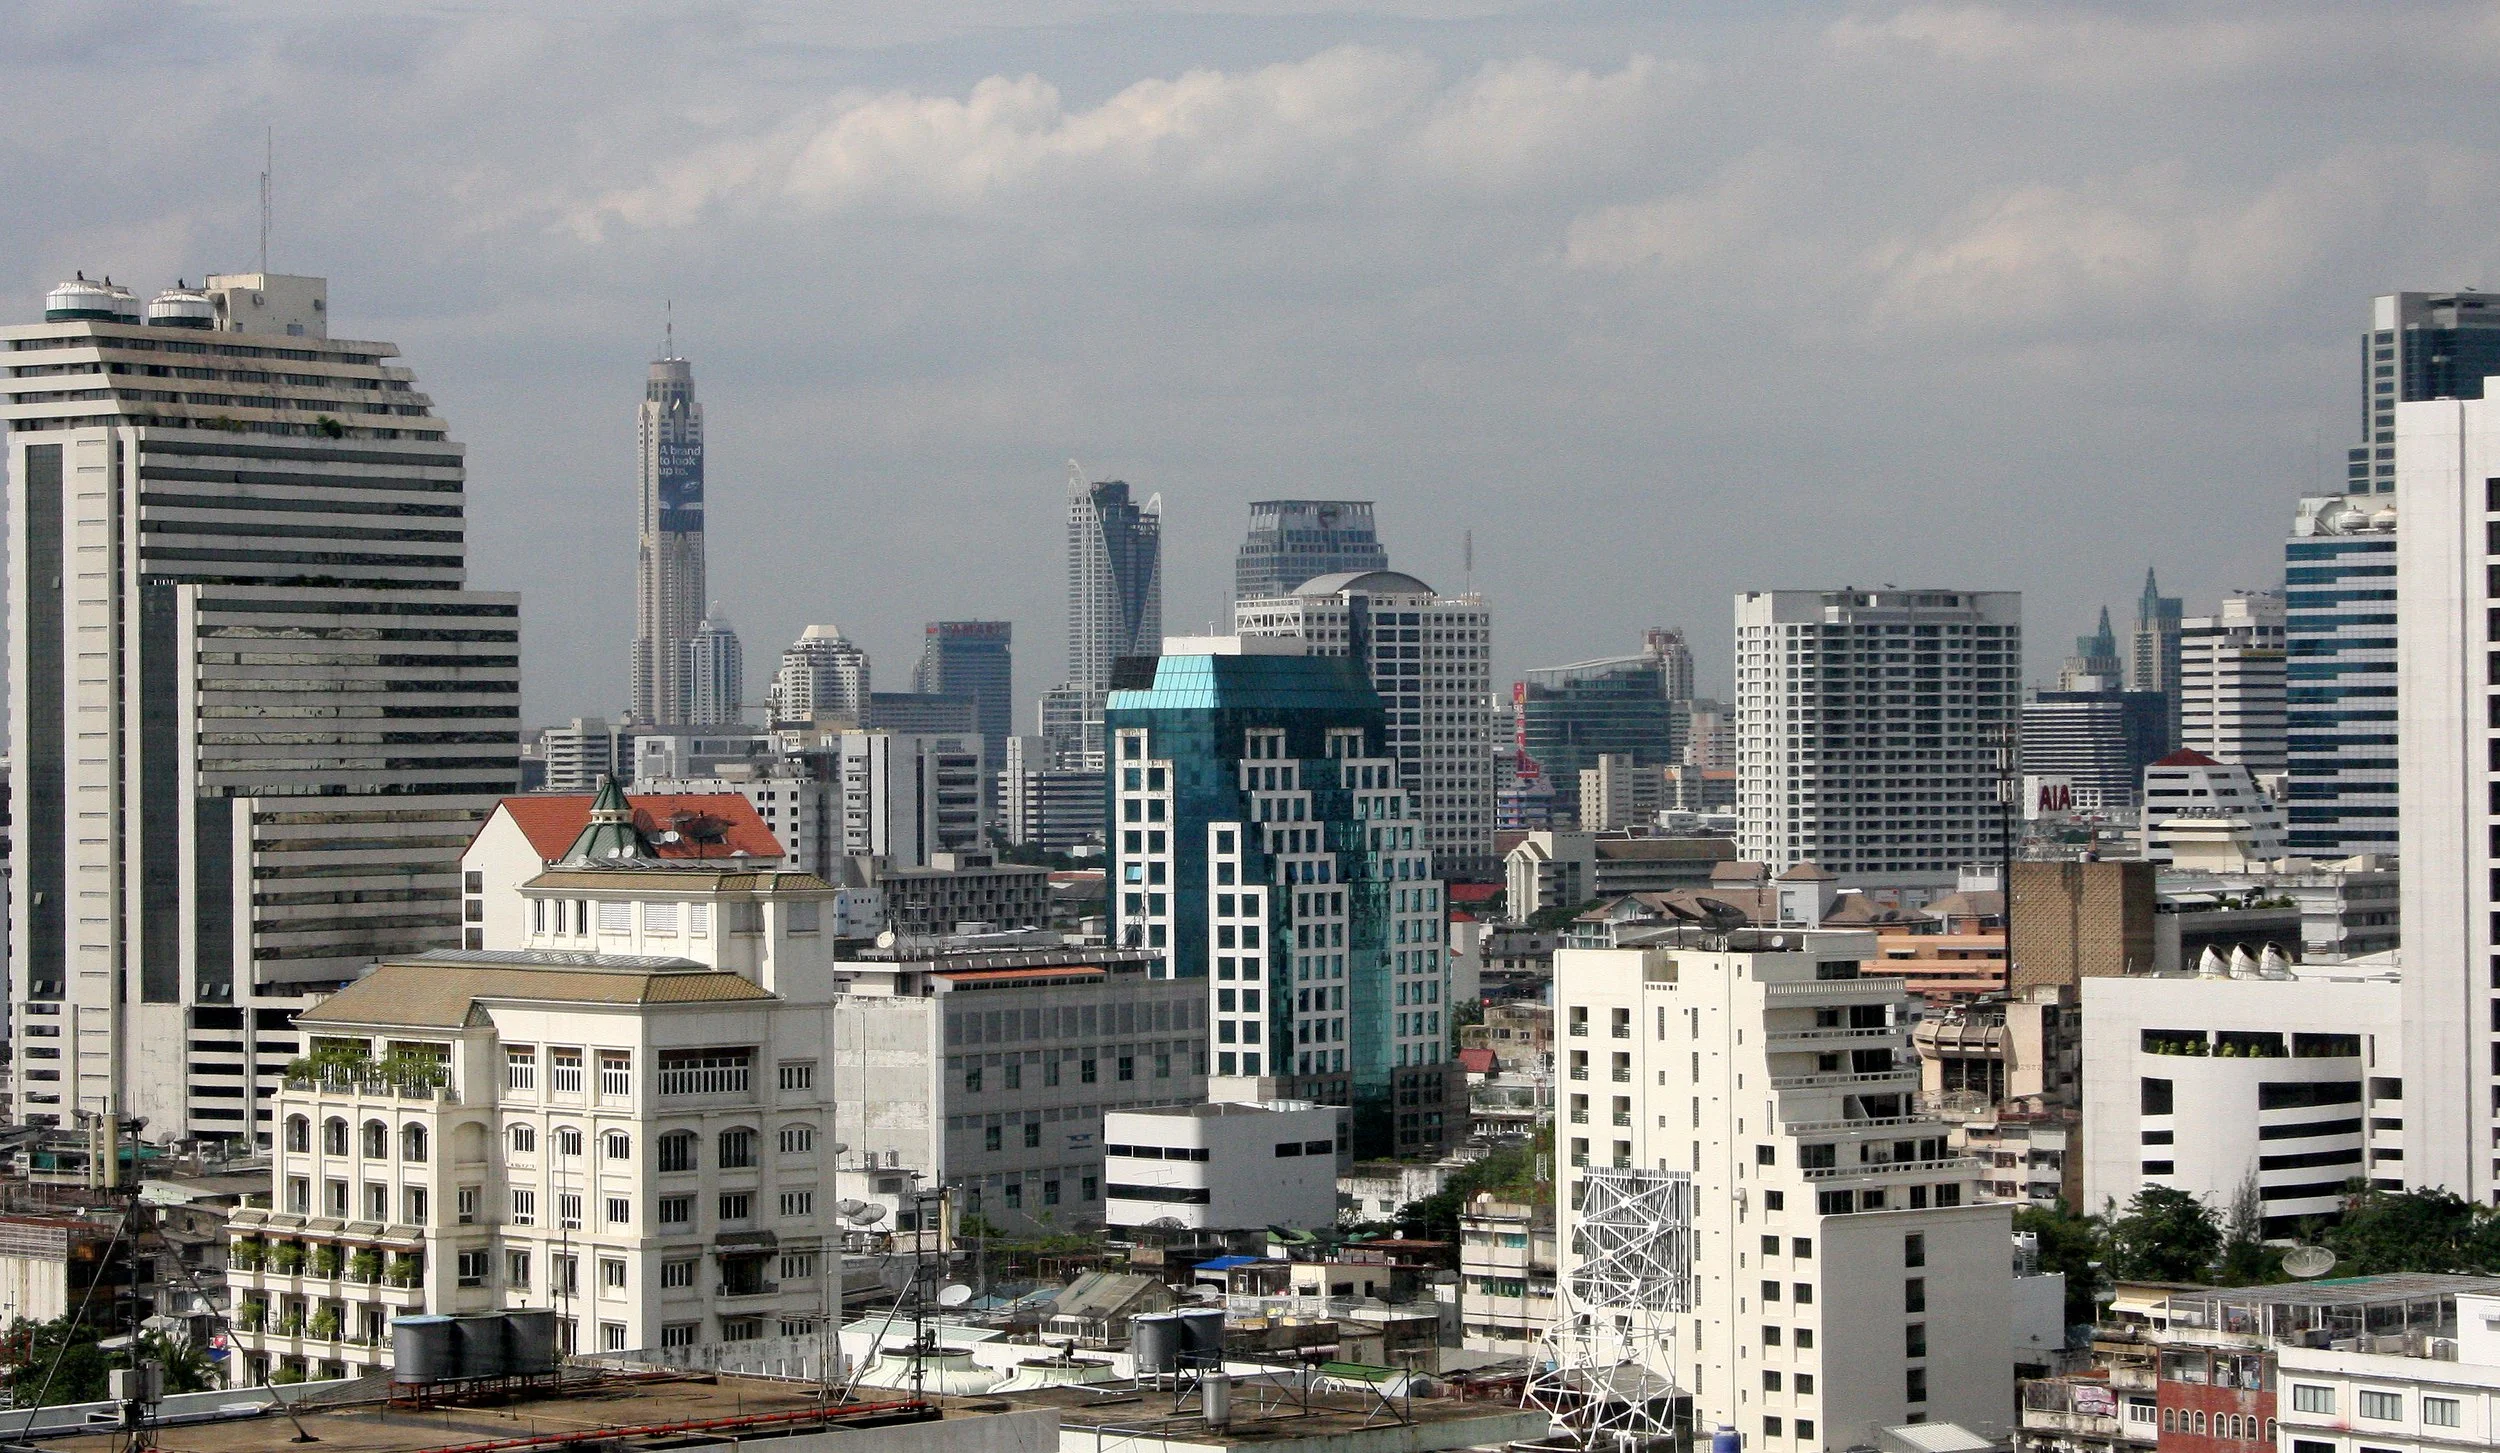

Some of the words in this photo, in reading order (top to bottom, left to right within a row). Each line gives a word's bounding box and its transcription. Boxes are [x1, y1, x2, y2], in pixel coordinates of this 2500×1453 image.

[660, 445, 668, 455] A
[670, 445, 701, 455] brand
[659, 456, 670, 465] to
[672, 456, 696, 465] look
[659, 467, 673, 477] up
[2038, 784, 2072, 812] AIA
